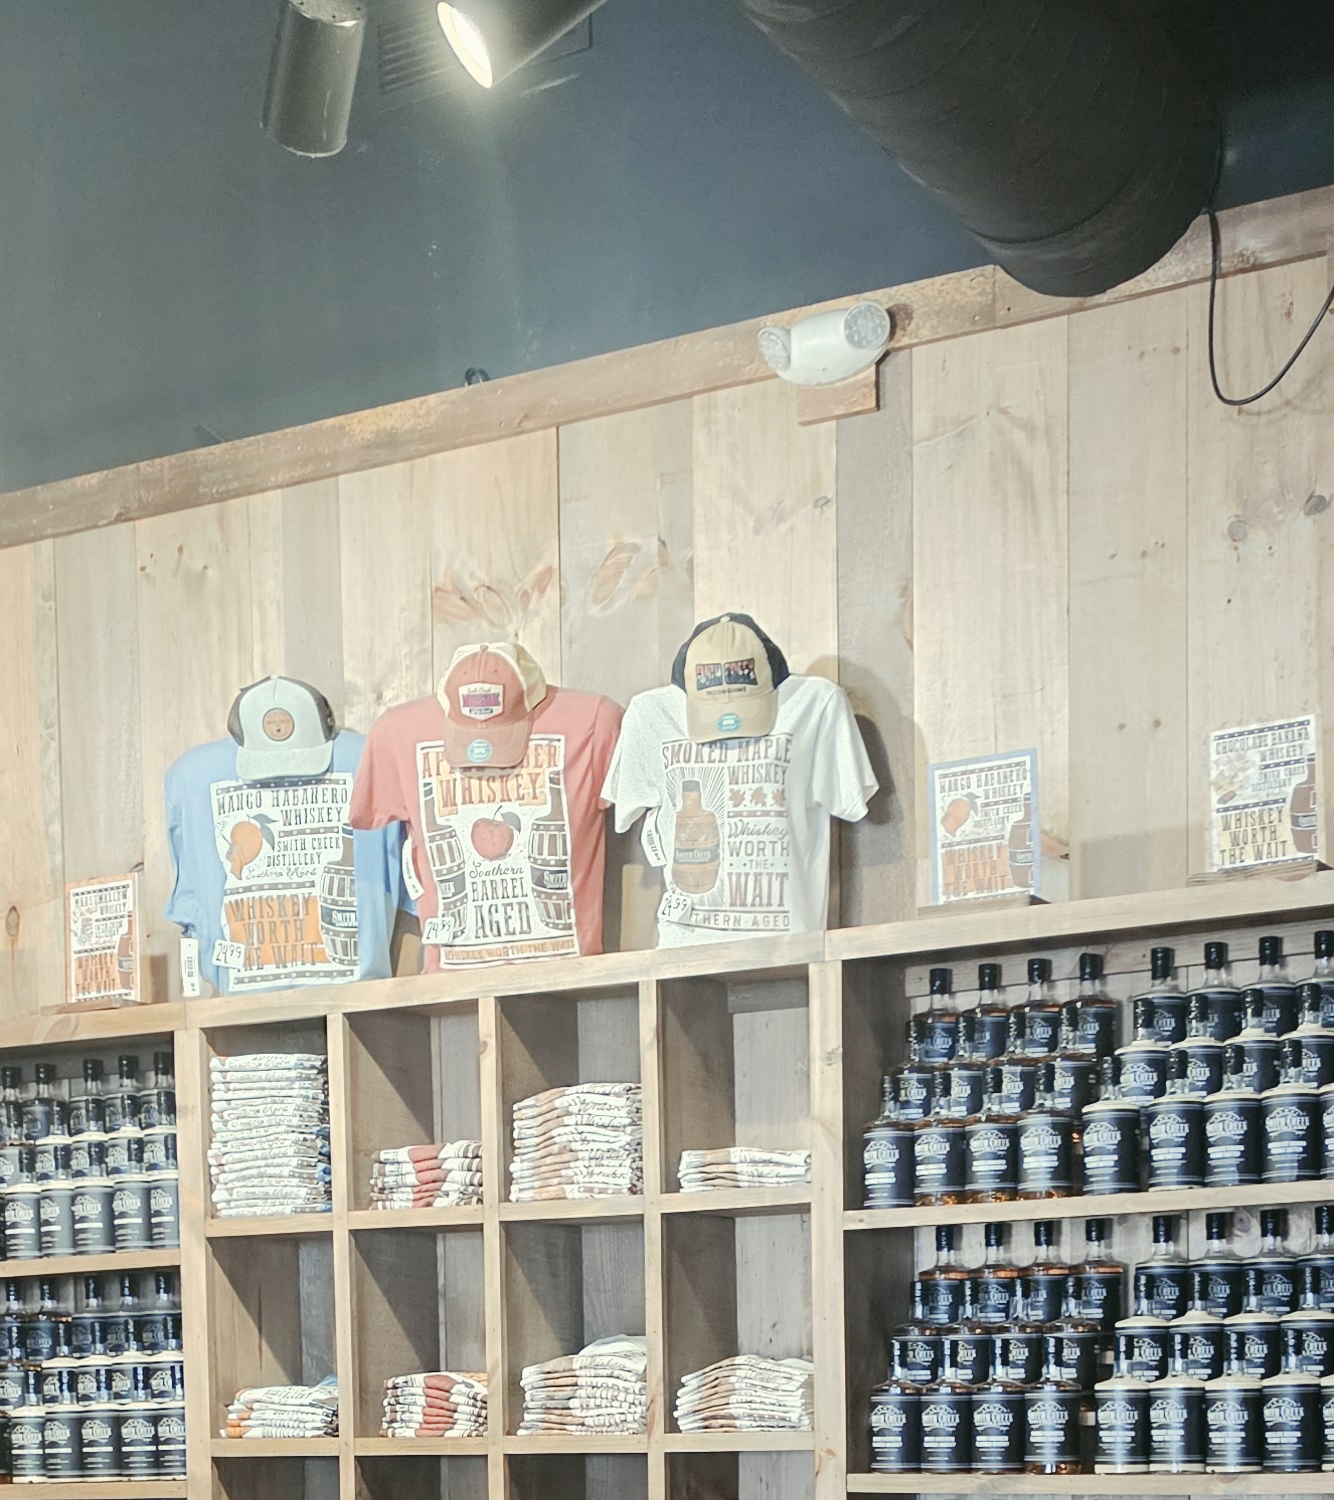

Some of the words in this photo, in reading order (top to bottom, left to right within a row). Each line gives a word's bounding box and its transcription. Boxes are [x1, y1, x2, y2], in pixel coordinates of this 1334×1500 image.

[1215, 735, 1269, 755] CHOCOLATE
[1271, 727, 1310, 746] BANANA
[1259, 743, 1305, 762] WHISKEY
[663, 739, 728, 769] SMOKED
[737, 737, 793, 763] MAPLE
[727, 763, 788, 786] WHISKEY
[939, 776, 972, 794] MANGO
[976, 767, 1027, 789] HABANERO
[217, 790, 263, 815] MANGO
[271, 787, 348, 808] HABANERO
[440, 772, 542, 808] WHISKEY
[983, 783, 1025, 800] WHISKEY
[280, 806, 344, 827] WHISKEY
[1221, 805, 1284, 831] WHISKEY
[728, 819, 790, 839] Whiskey
[1229, 825, 1278, 847] WORTH
[277, 838, 306, 853] SMITH
[311, 836, 341, 851] CREEK
[727, 841, 790, 858] WORTH
[947, 842, 1003, 866] WHISKEY
[1220, 847, 1245, 866] THE
[1252, 840, 1288, 861] WAIT
[267, 851, 322, 868] DISTILLERY
[469, 861, 525, 879] Southern
[748, 859, 769, 870] THE
[953, 861, 997, 881] WORTH
[471, 877, 528, 902] BARREL
[727, 872, 789, 908] WAIT
[945, 881, 968, 899] THE
[975, 876, 1006, 894] WAIT
[228, 892, 314, 923] WHISKEY
[474, 901, 532, 939] AGED
[694, 913, 742, 927] THERN
[751, 915, 790, 927] AGED
[243, 919, 304, 946] WORTH
[237, 945, 264, 973] HE
[271, 942, 317, 969] WAIT
[444, 947, 484, 961] WHISKEY
[528, 942, 547, 953] THE
[550, 938, 575, 950] WAIT
